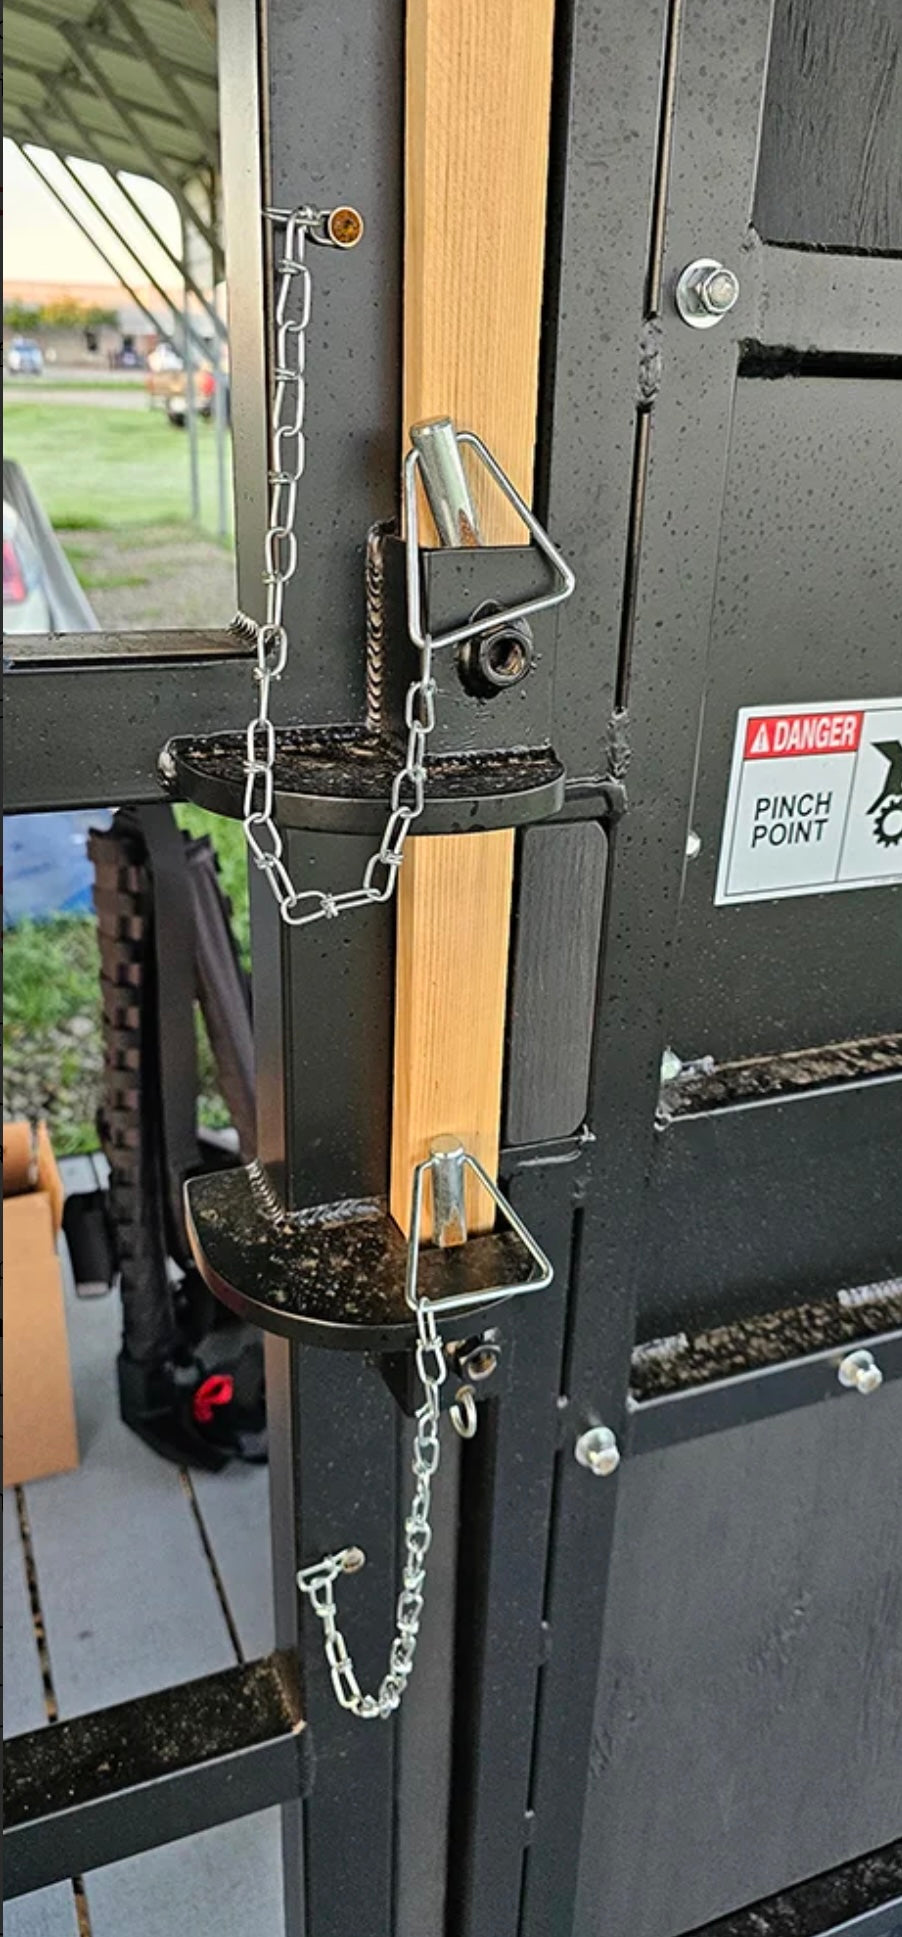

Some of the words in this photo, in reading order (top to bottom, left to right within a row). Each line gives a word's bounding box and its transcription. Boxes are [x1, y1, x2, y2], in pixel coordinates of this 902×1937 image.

[773, 715, 857, 752] DANGER
[754, 791, 833, 820] PINCH
[751, 818, 829, 848] POINT
